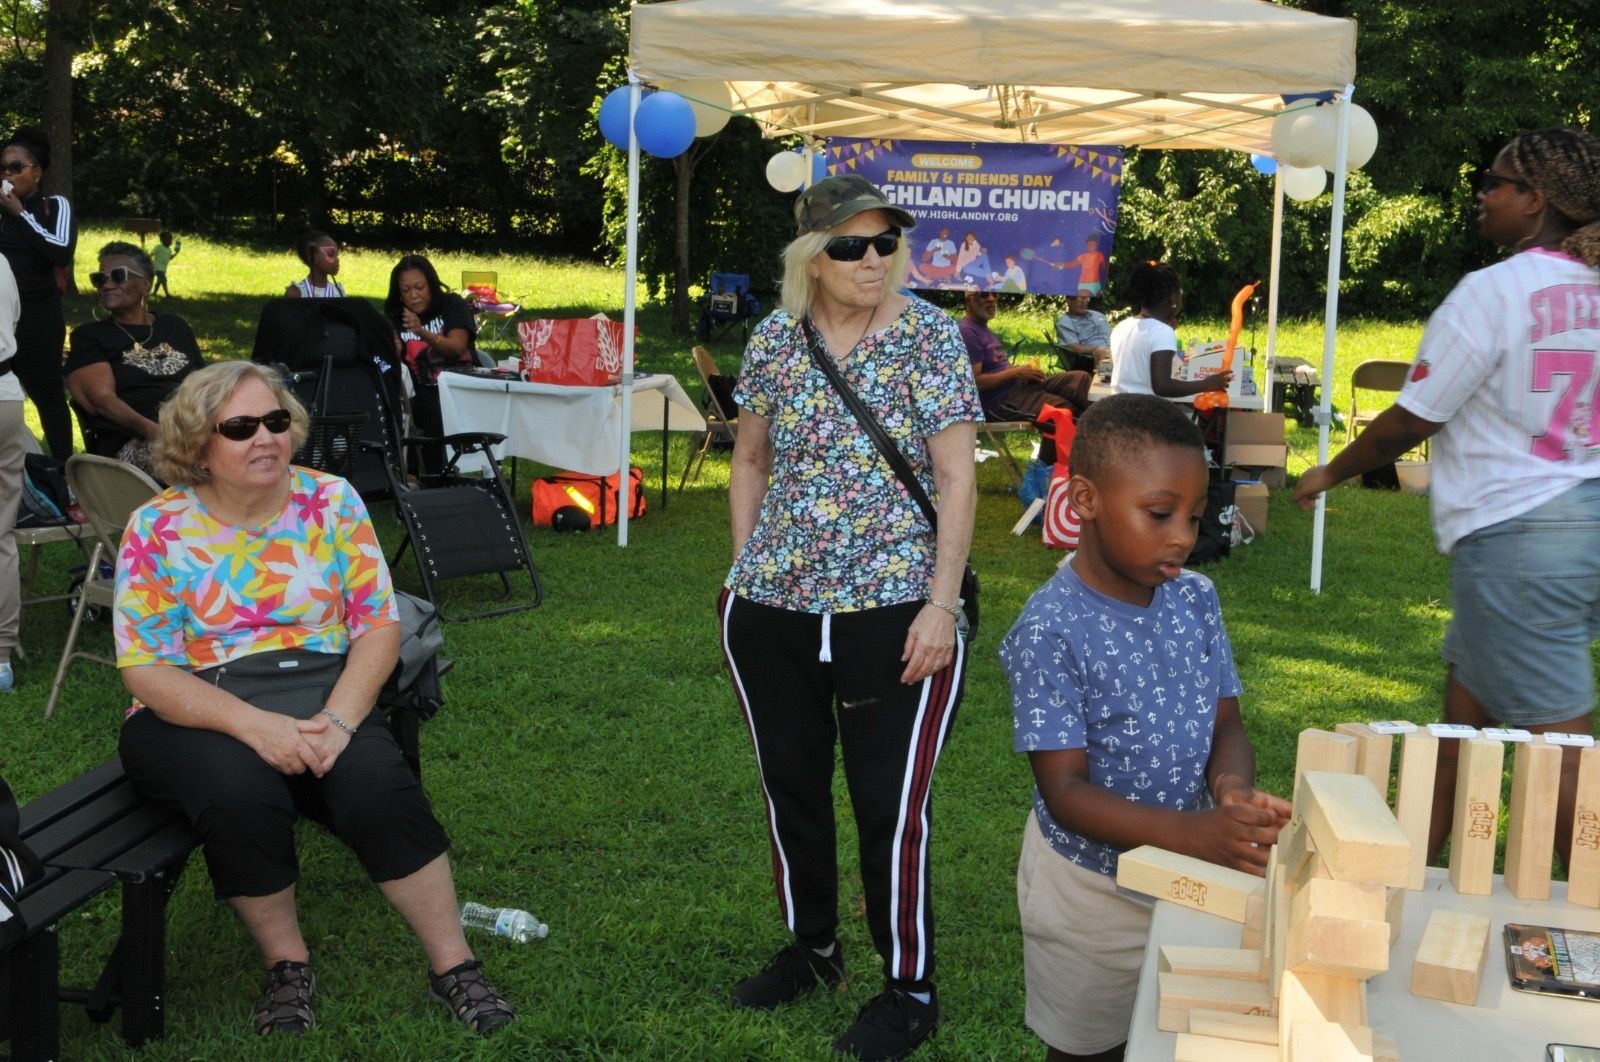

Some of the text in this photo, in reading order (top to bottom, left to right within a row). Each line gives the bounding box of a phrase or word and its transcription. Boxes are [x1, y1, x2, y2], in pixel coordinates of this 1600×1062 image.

[919, 157, 975, 167] WELCOME
[887, 170, 1054, 188] FAMILY & FRIENDS DAY
[873, 184, 1090, 212] GHLAND CHURCH
[904, 208, 1019, 222] WW.HIGHLANDNY.ORG
[1467, 801, 1495, 840] Jenga
[1171, 876, 1208, 906] Jenga
